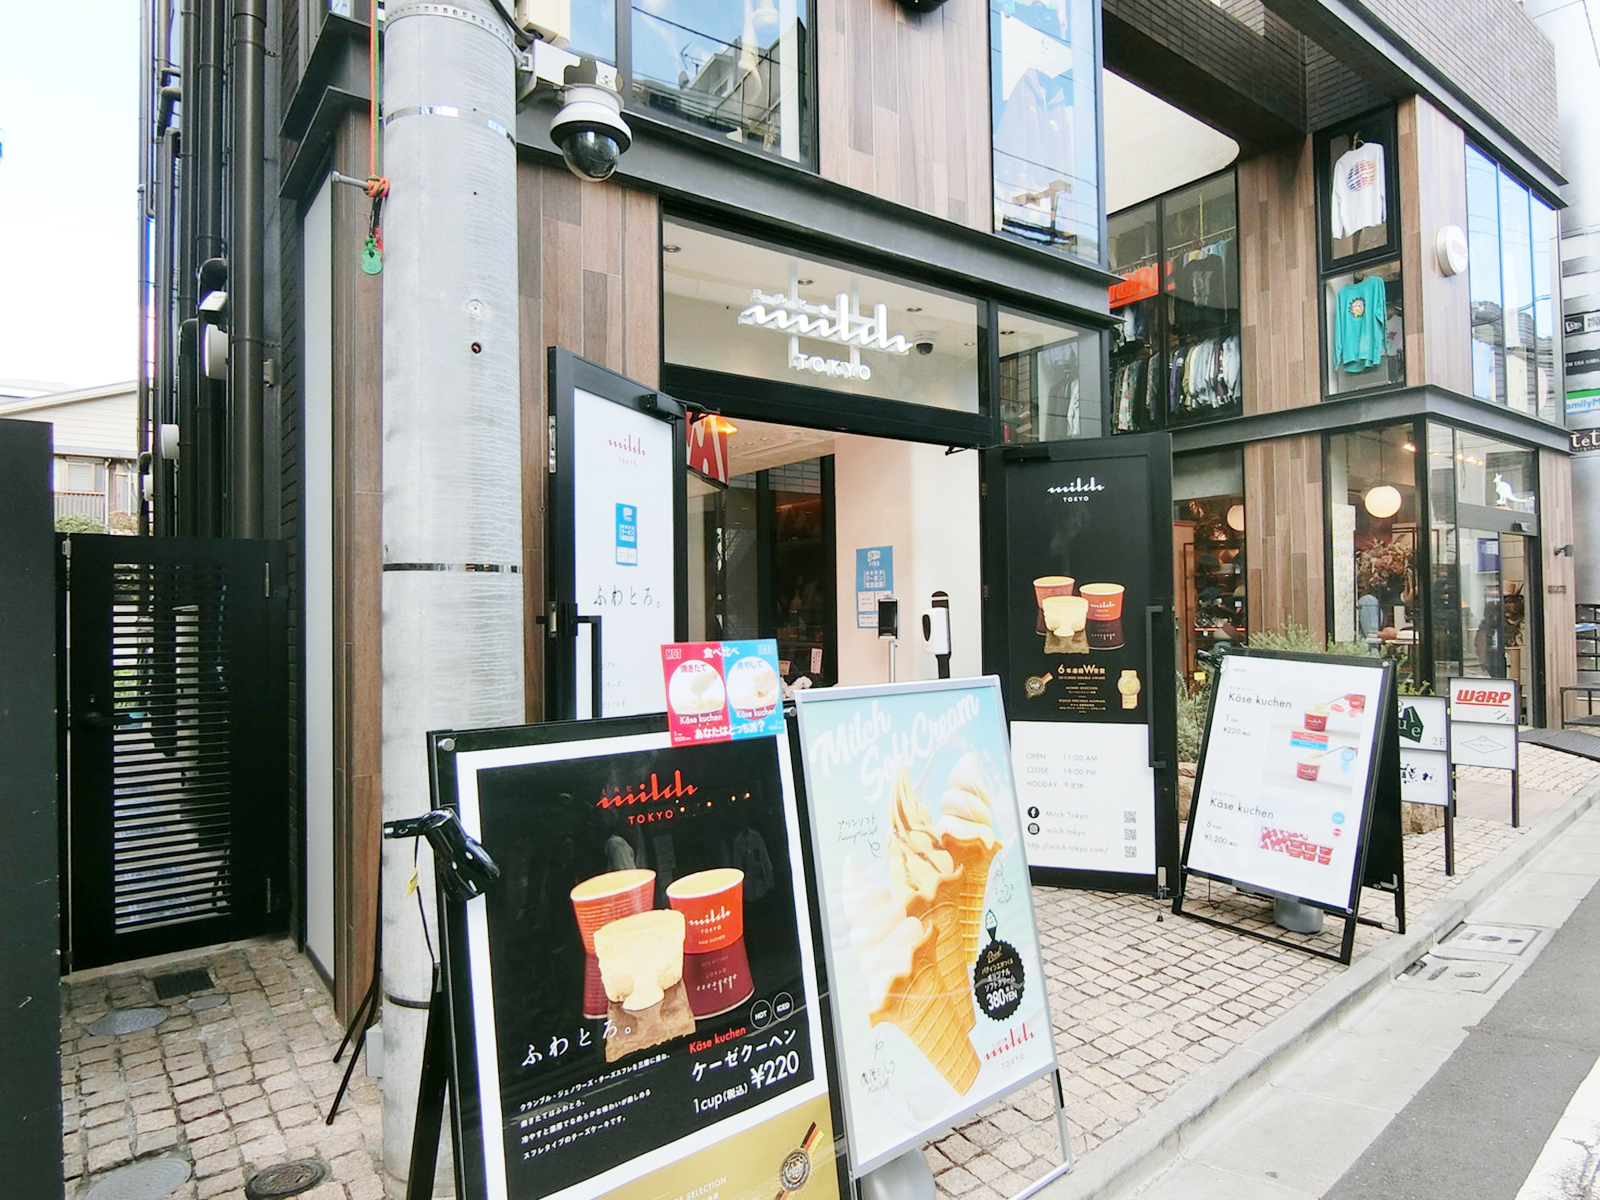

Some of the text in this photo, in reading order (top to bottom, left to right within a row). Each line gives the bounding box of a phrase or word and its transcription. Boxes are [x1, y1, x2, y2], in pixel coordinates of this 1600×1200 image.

[738, 293, 914, 352] milch
[797, 353, 871, 381] TOKYO
[1565, 398, 1600, 410] amilyM
[607, 434, 646, 456] milch
[1047, 476, 1105, 494] milch
[593, 584, 661, 609] ふわとろ。
[665, 649, 682, 659] HOT
[703, 647, 740, 659] 食べ比べ
[681, 664, 707, 673] 焼きたて
[1228, 692, 1292, 708] Käse kuchen
[808, 699, 891, 779] Milch
[596, 769, 698, 809] milch
[627, 809, 674, 826] TOKYO
[1067, 811, 1088, 820] Tokyo
[1209, 797, 1274, 819] Käse kuchen
[688, 905, 731, 926] milch
[701, 924, 722, 934] TOKYO
[754, 1002, 790, 1020] HOT ICED
[521, 1019, 632, 1067] ふわとろ。
[688, 1026, 747, 1054] Käse kuchen
[984, 1022, 1036, 1060] milch
[692, 1029, 796, 1082] ケーゼクーヘン
[1001, 1053, 1024, 1069] TOKYO
[750, 1050, 800, 1089] ¥220
[523, 1115, 627, 1160] スフレタイプのチーズケーキです。
[686, 1176, 727, 1200] SELECTION
